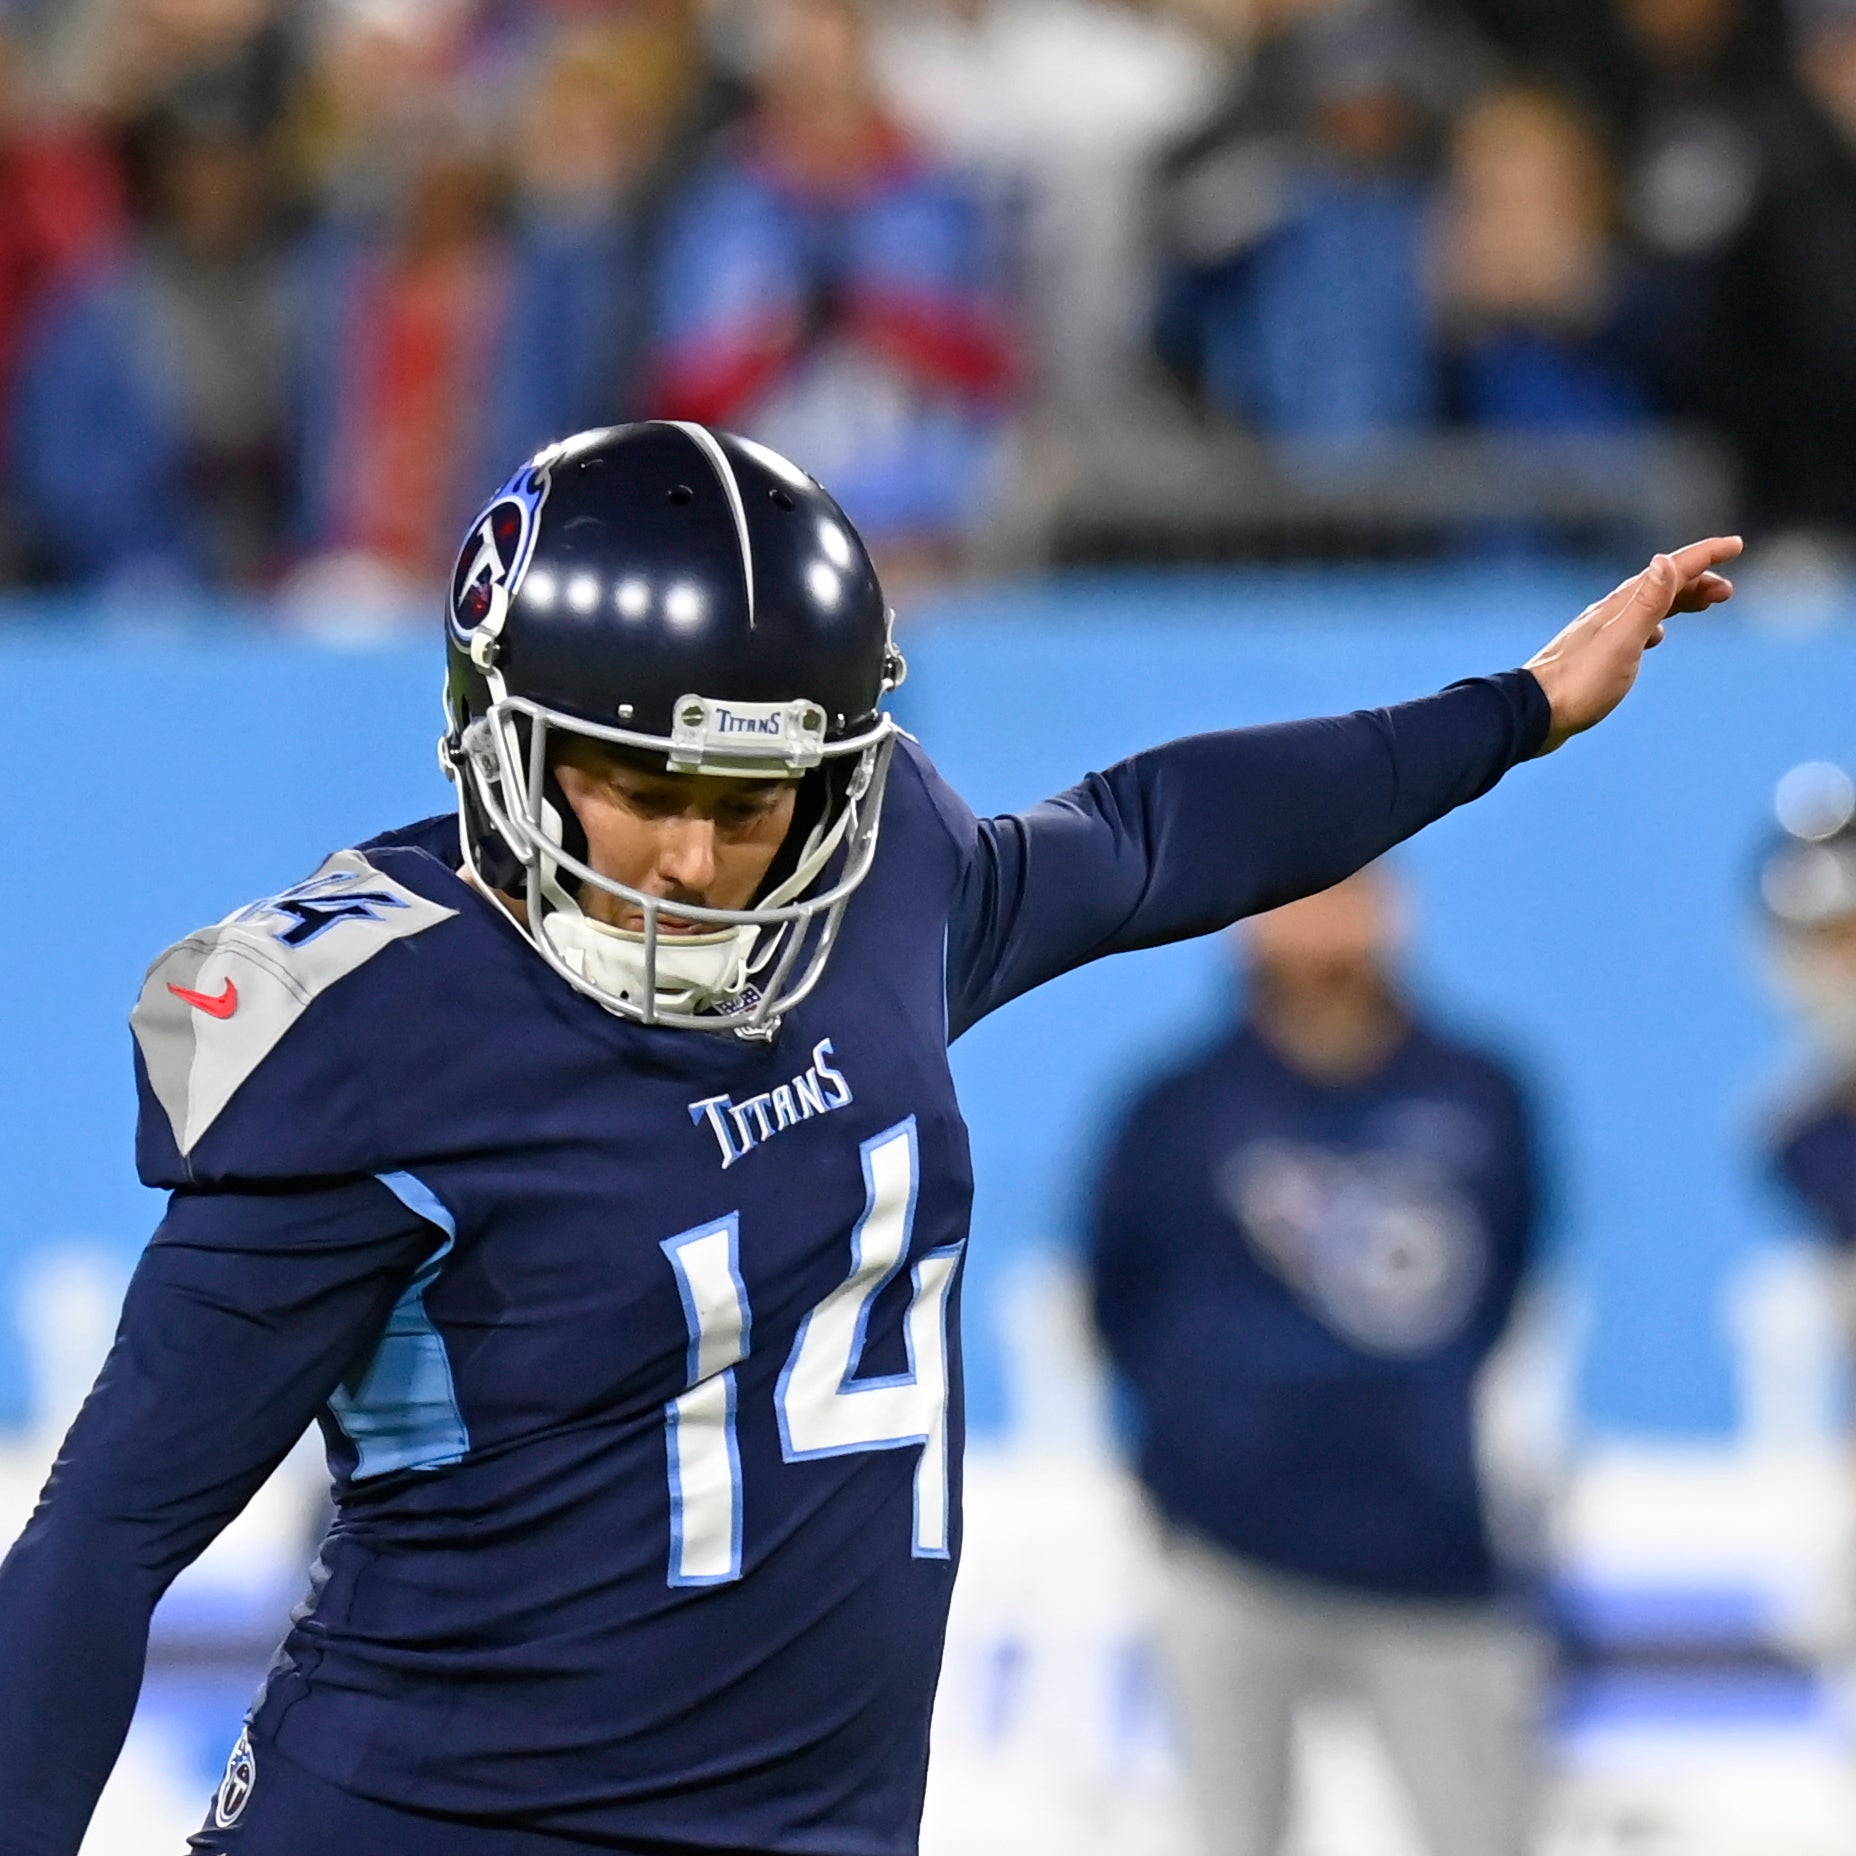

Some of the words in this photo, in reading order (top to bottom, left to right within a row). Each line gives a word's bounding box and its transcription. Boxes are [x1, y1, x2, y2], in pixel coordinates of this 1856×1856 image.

[715, 708, 782, 735] TITANS
[689, 1037, 854, 1170] TITANS
[658, 1112, 967, 1590] 14
